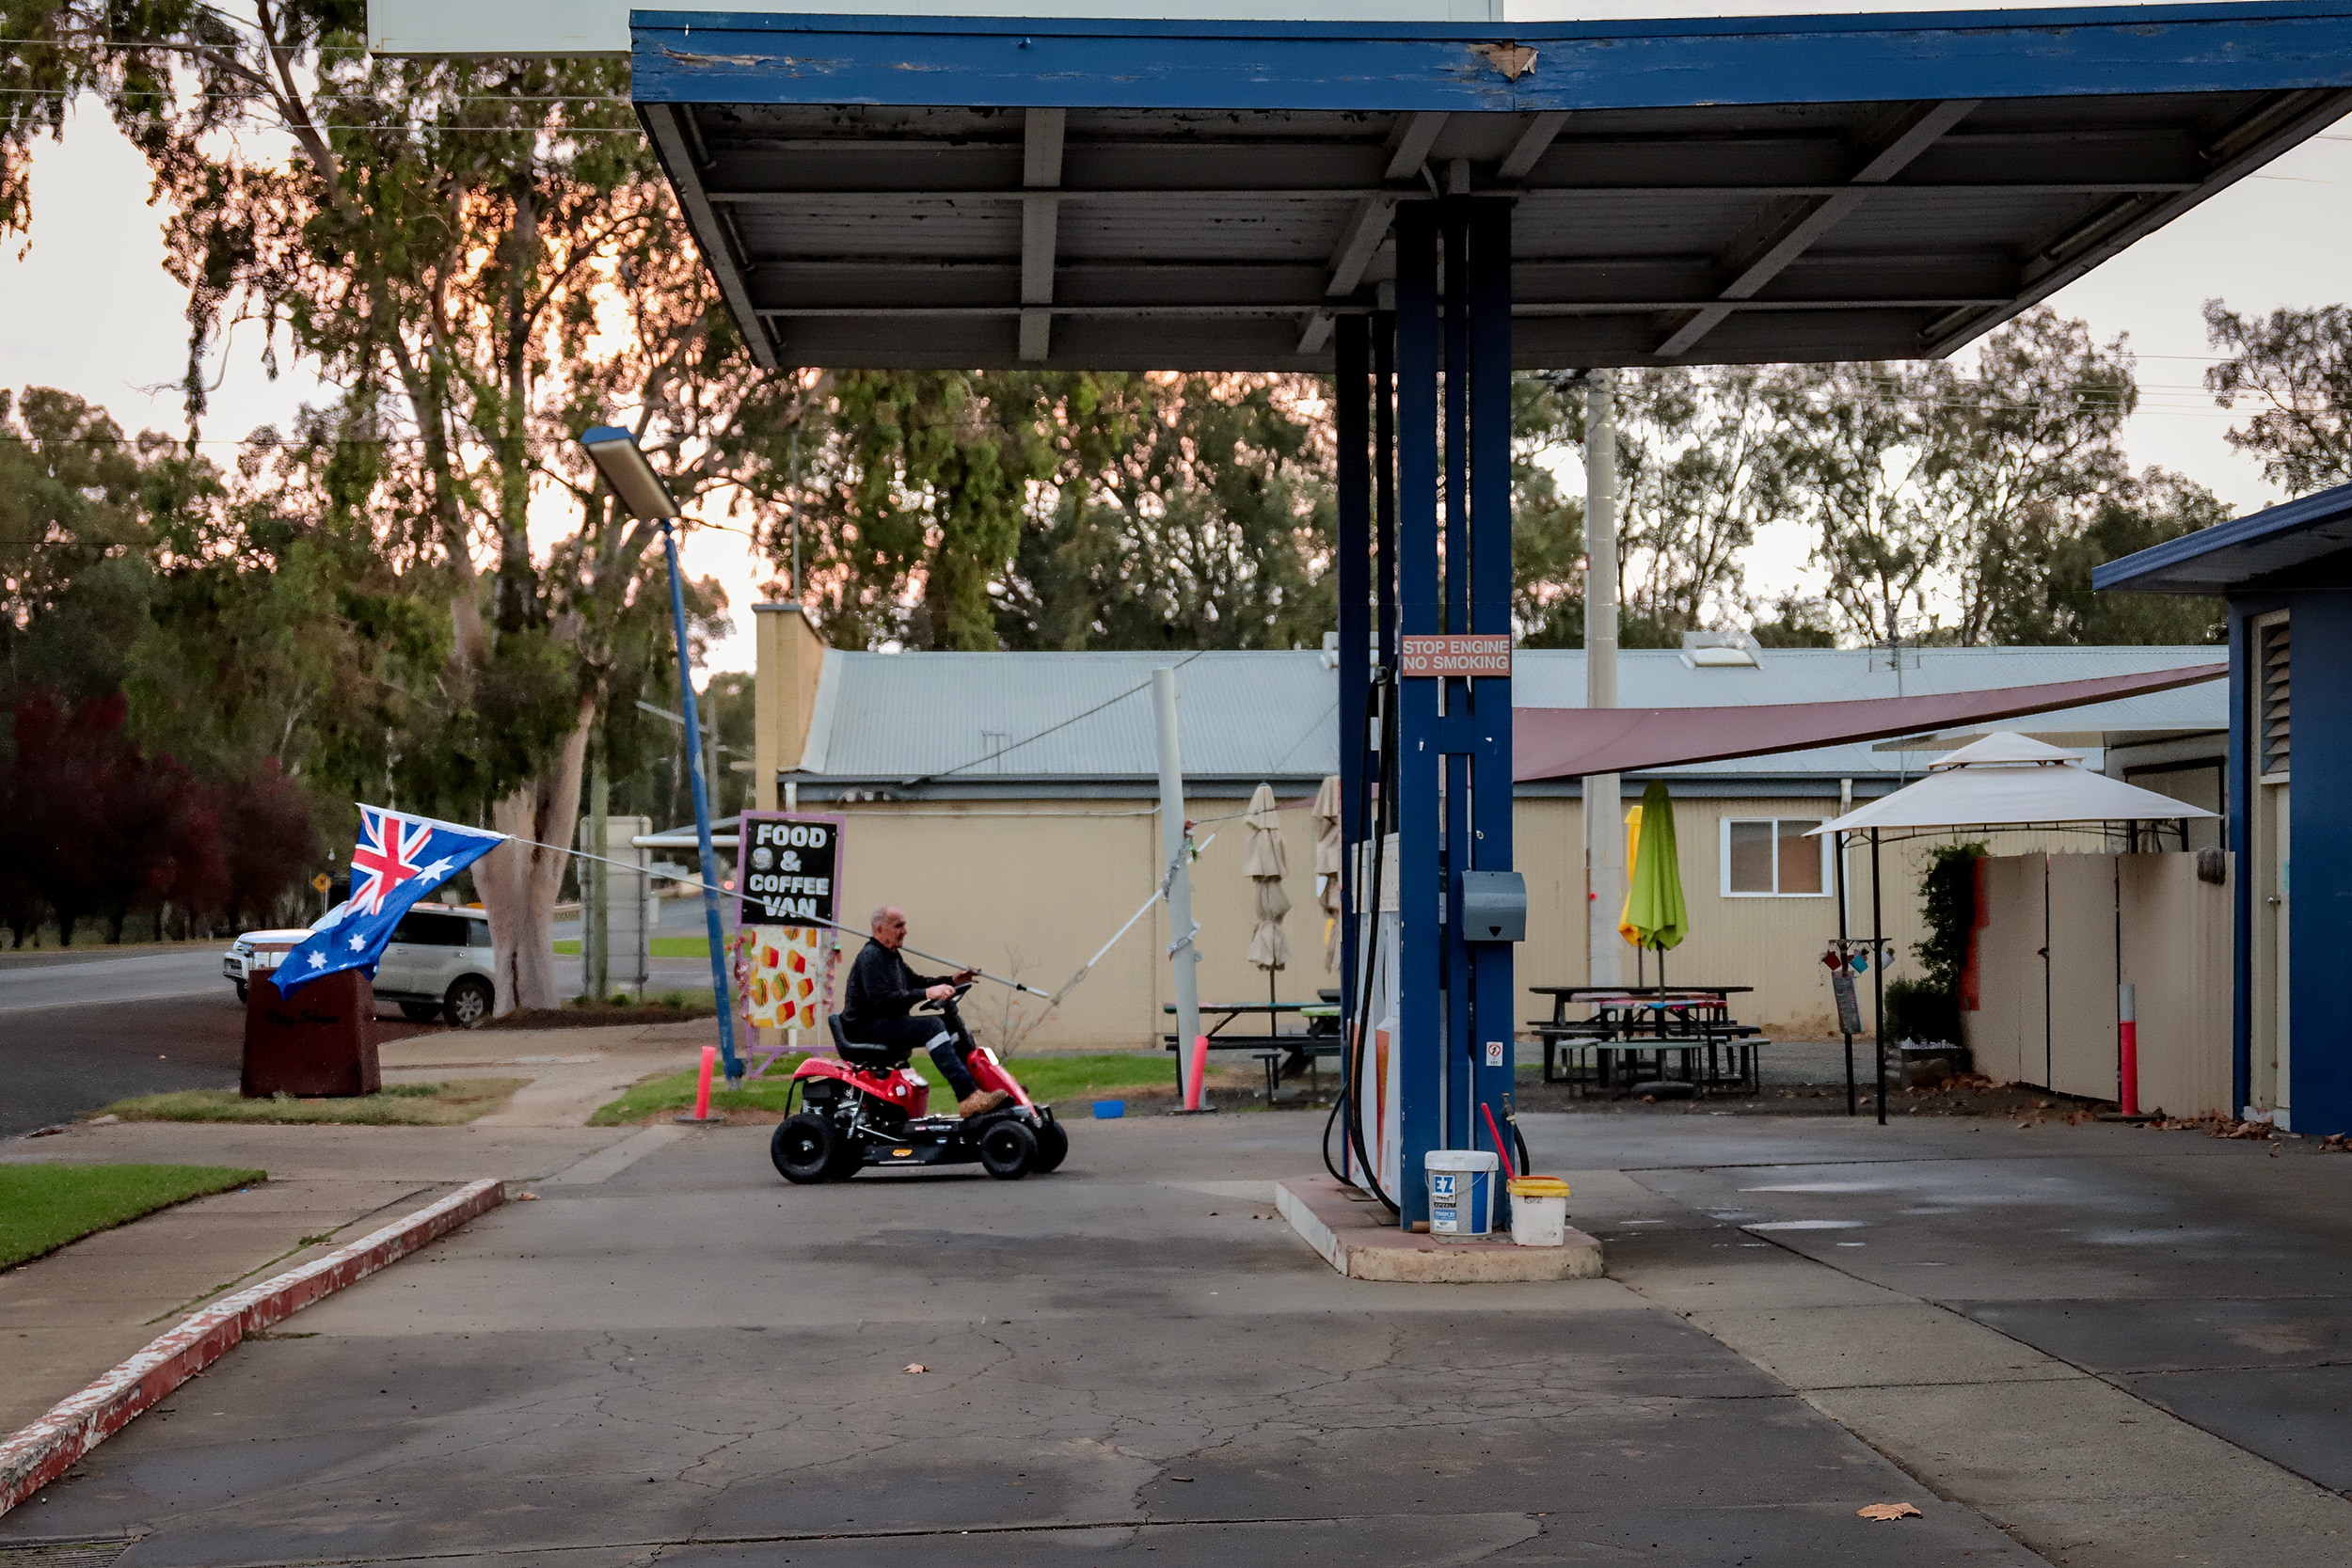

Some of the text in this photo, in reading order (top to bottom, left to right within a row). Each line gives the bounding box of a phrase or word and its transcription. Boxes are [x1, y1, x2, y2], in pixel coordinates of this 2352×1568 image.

[1403, 641, 1509, 655] STOP ENGINE
[1403, 656, 1508, 670] NO SMOKING
[756, 824, 827, 847] FOOD
[780, 850, 802, 872] &
[749, 874, 830, 895] COFFEE
[762, 895, 817, 919] VAN
[1435, 1177, 1454, 1194] EZ
